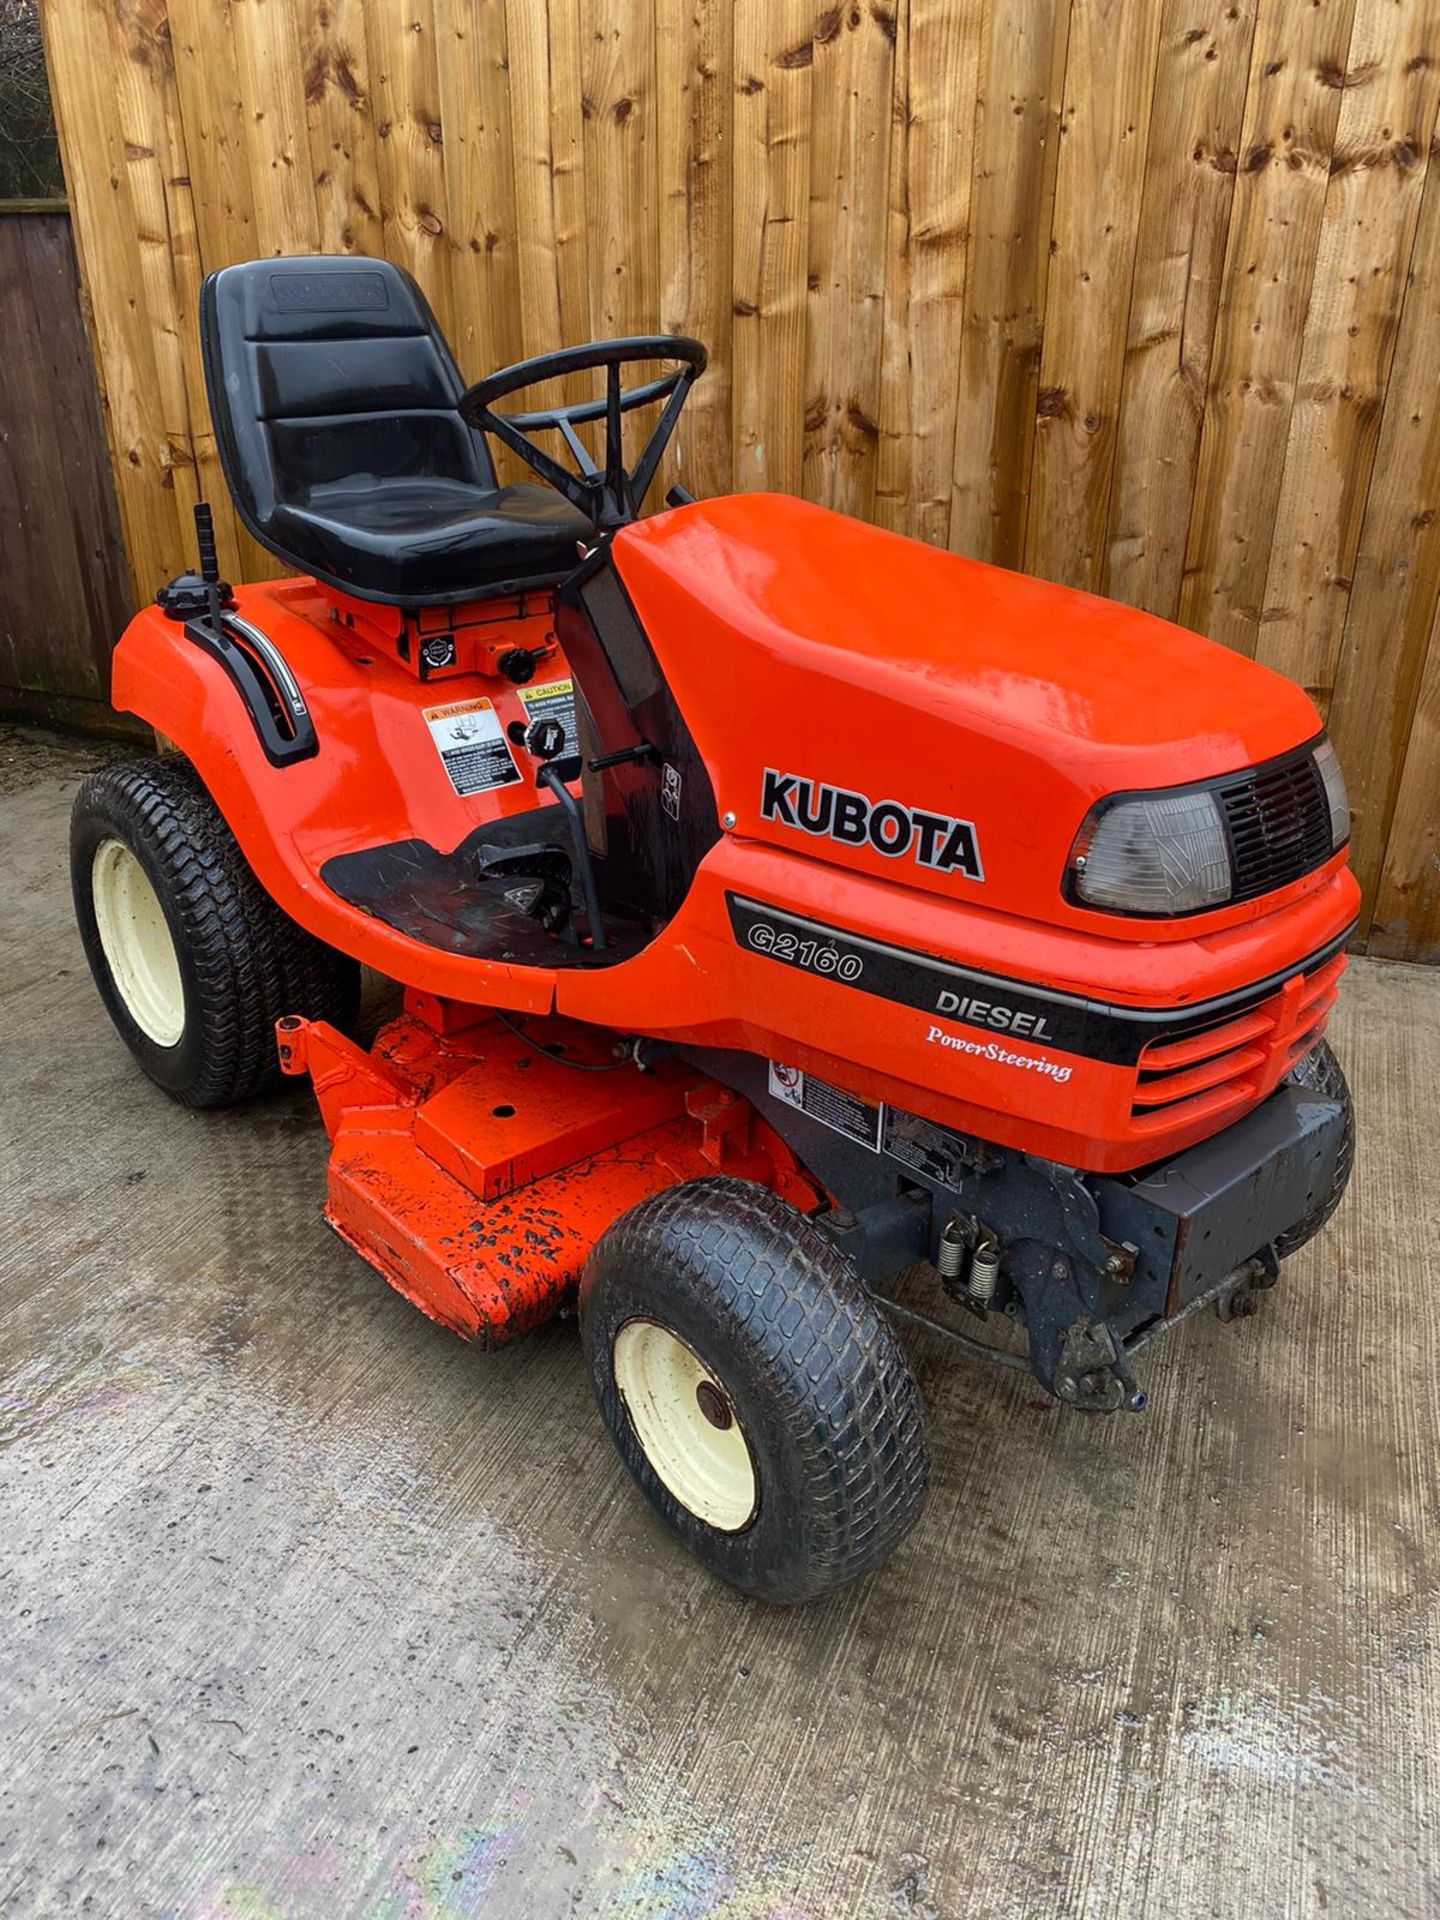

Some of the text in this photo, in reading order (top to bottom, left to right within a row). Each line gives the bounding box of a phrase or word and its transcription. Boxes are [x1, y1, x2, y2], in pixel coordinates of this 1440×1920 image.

[443, 701, 483, 716] WARNING
[536, 684, 571, 696] CAUTION
[760, 767, 985, 882] KUBOTA
[748, 923, 863, 980] G2160
[935, 990, 1053, 1041] DIESEL
[926, 1026, 1073, 1082] PowerSteering
